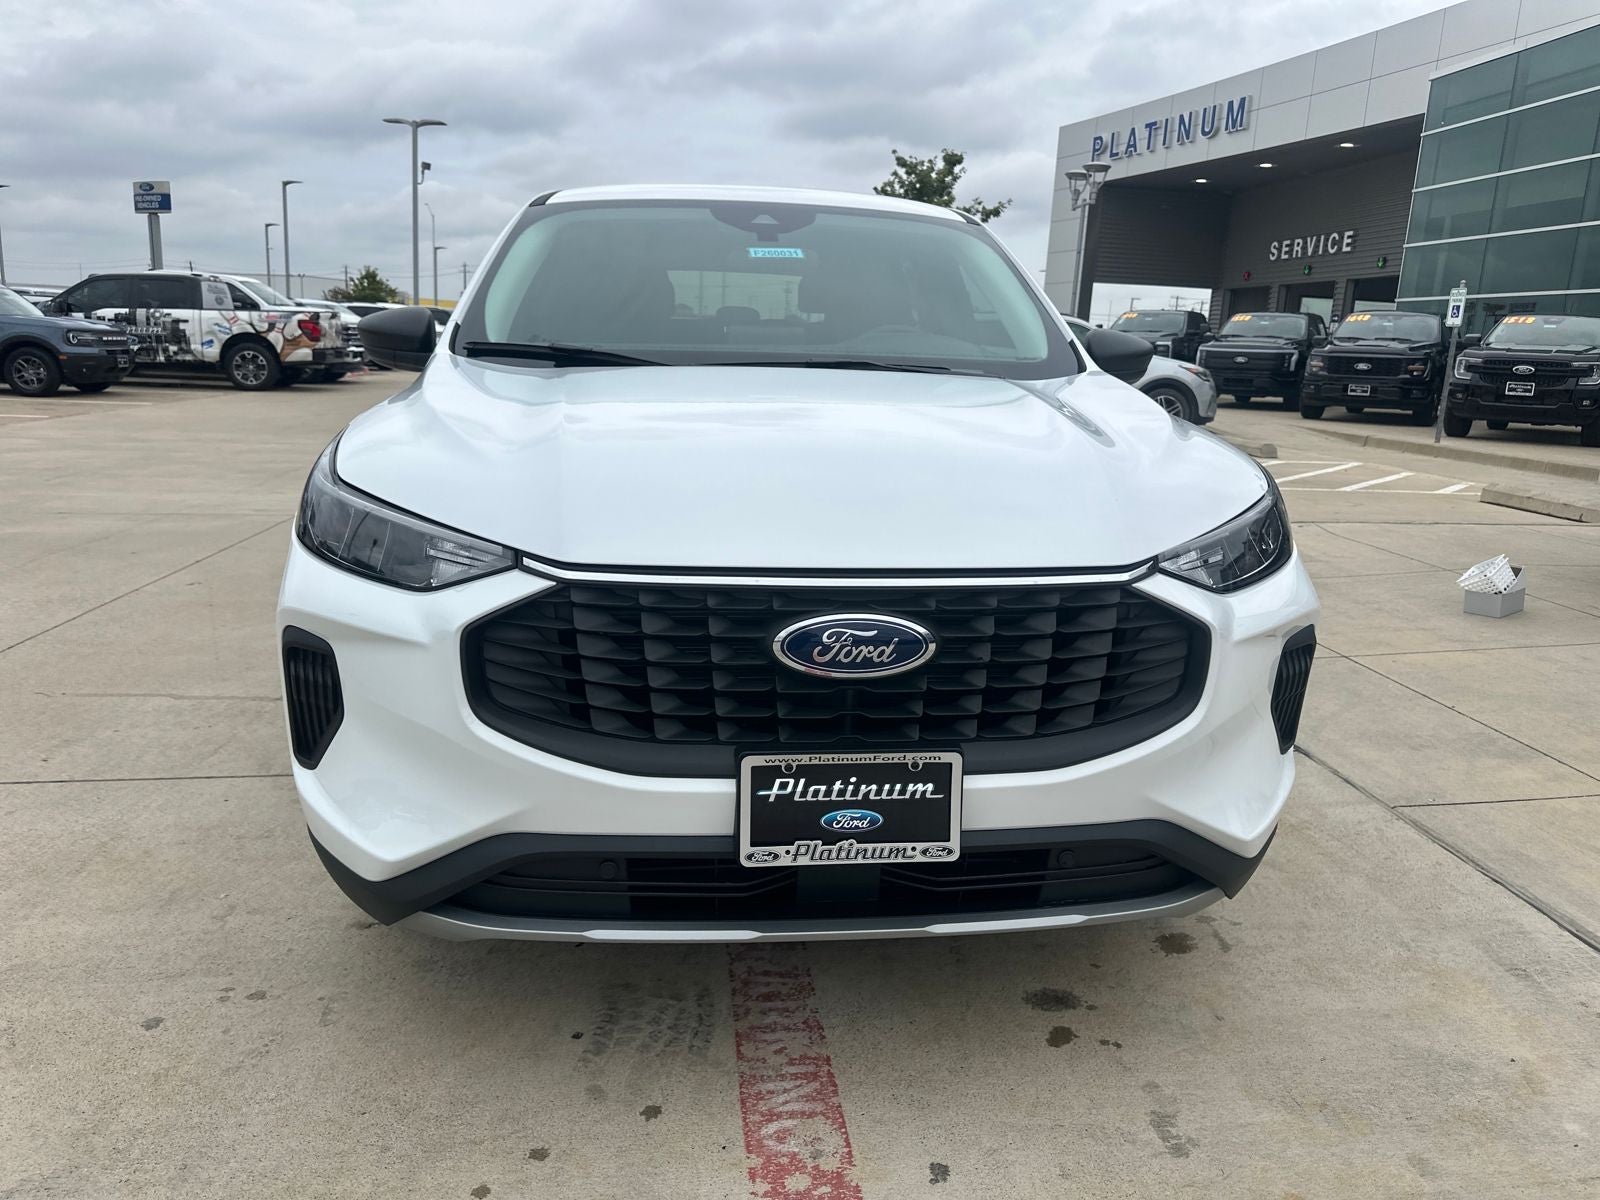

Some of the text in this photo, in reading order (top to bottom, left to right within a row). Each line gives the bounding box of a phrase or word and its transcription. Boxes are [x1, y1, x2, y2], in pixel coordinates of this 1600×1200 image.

[1091, 96, 1248, 162] PLATINUM
[753, 249, 800, 257] F260031
[1269, 230, 1354, 261] SERVICE
[812, 628, 899, 663] Ford
[764, 755, 942, 763] www.PlatinumFord.com
[756, 777, 945, 802] Platinum
[832, 812, 871, 828] Ford
[791, 840, 918, 863] Platinum
